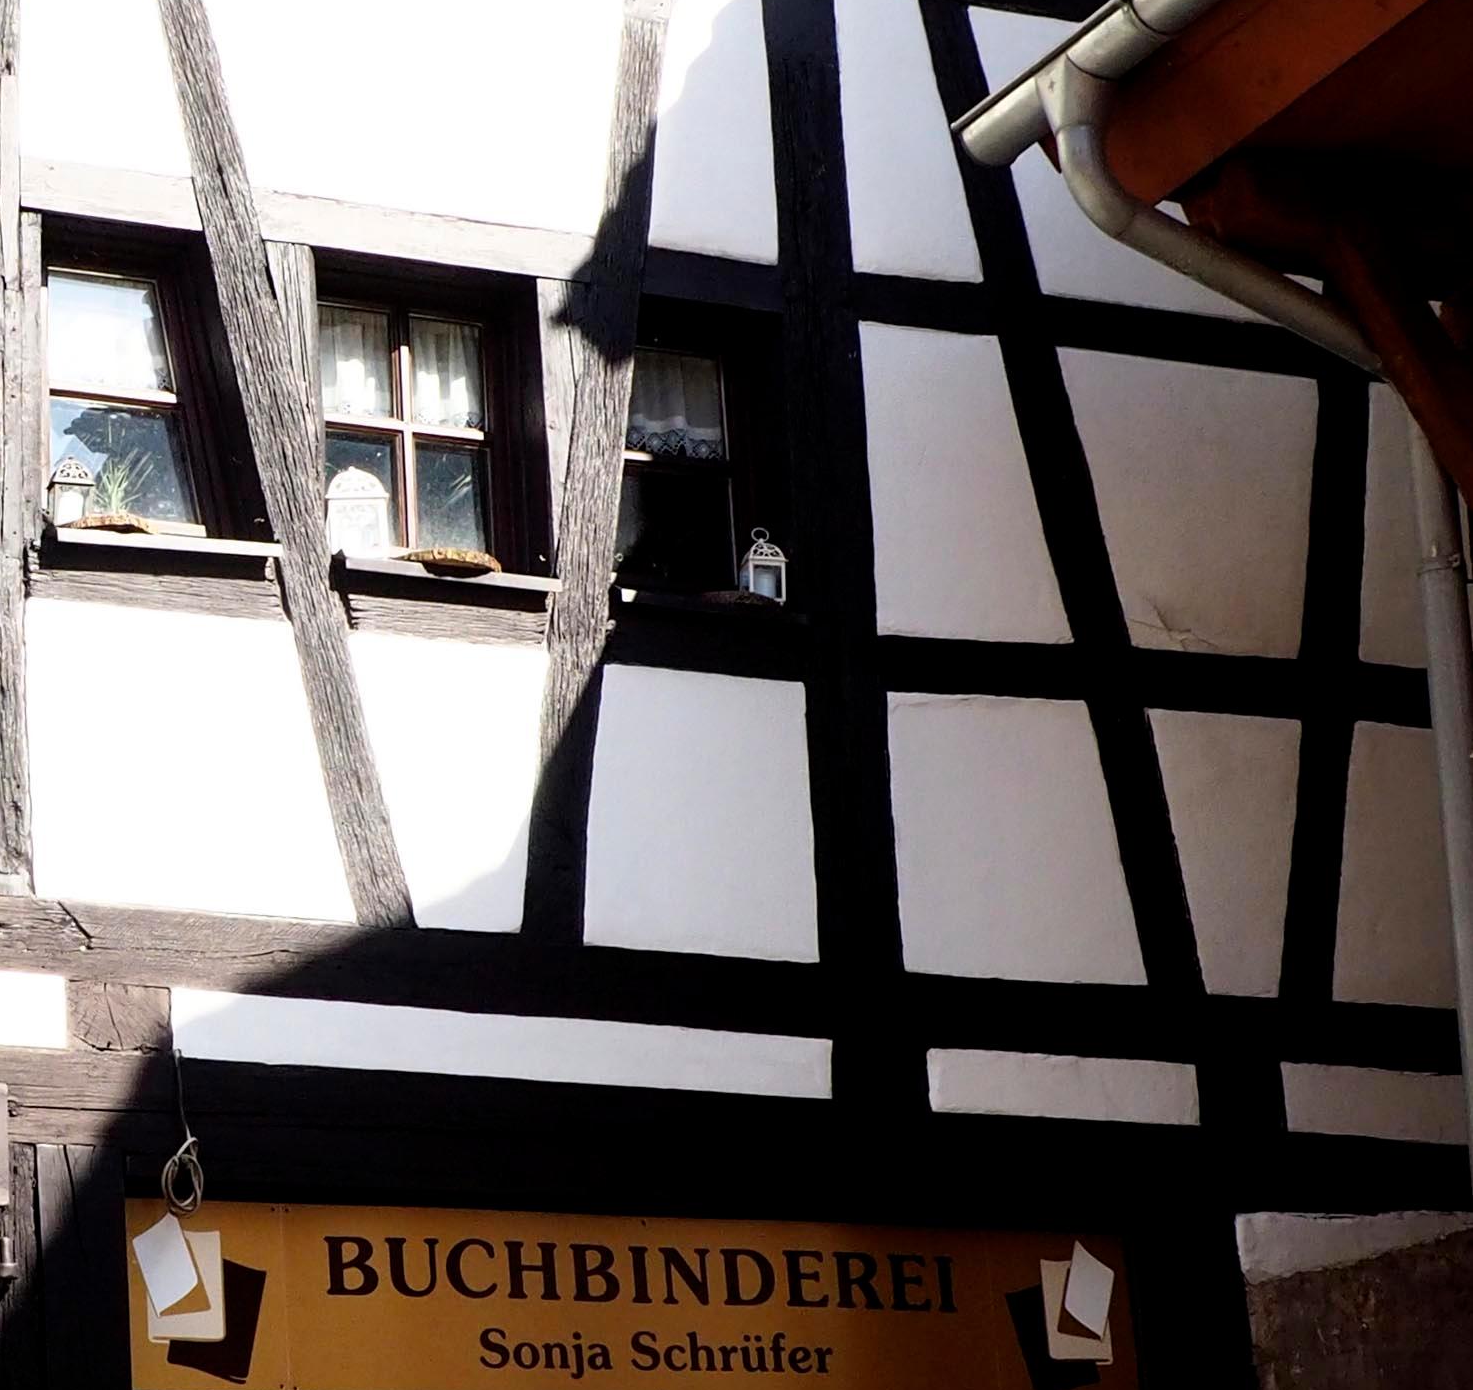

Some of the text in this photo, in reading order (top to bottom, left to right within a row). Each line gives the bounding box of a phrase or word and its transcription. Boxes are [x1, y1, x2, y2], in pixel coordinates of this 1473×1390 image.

[323, 1236, 959, 1313] BUCHBINDEREI
[479, 1327, 833, 1380] Sonja Schrüfer
